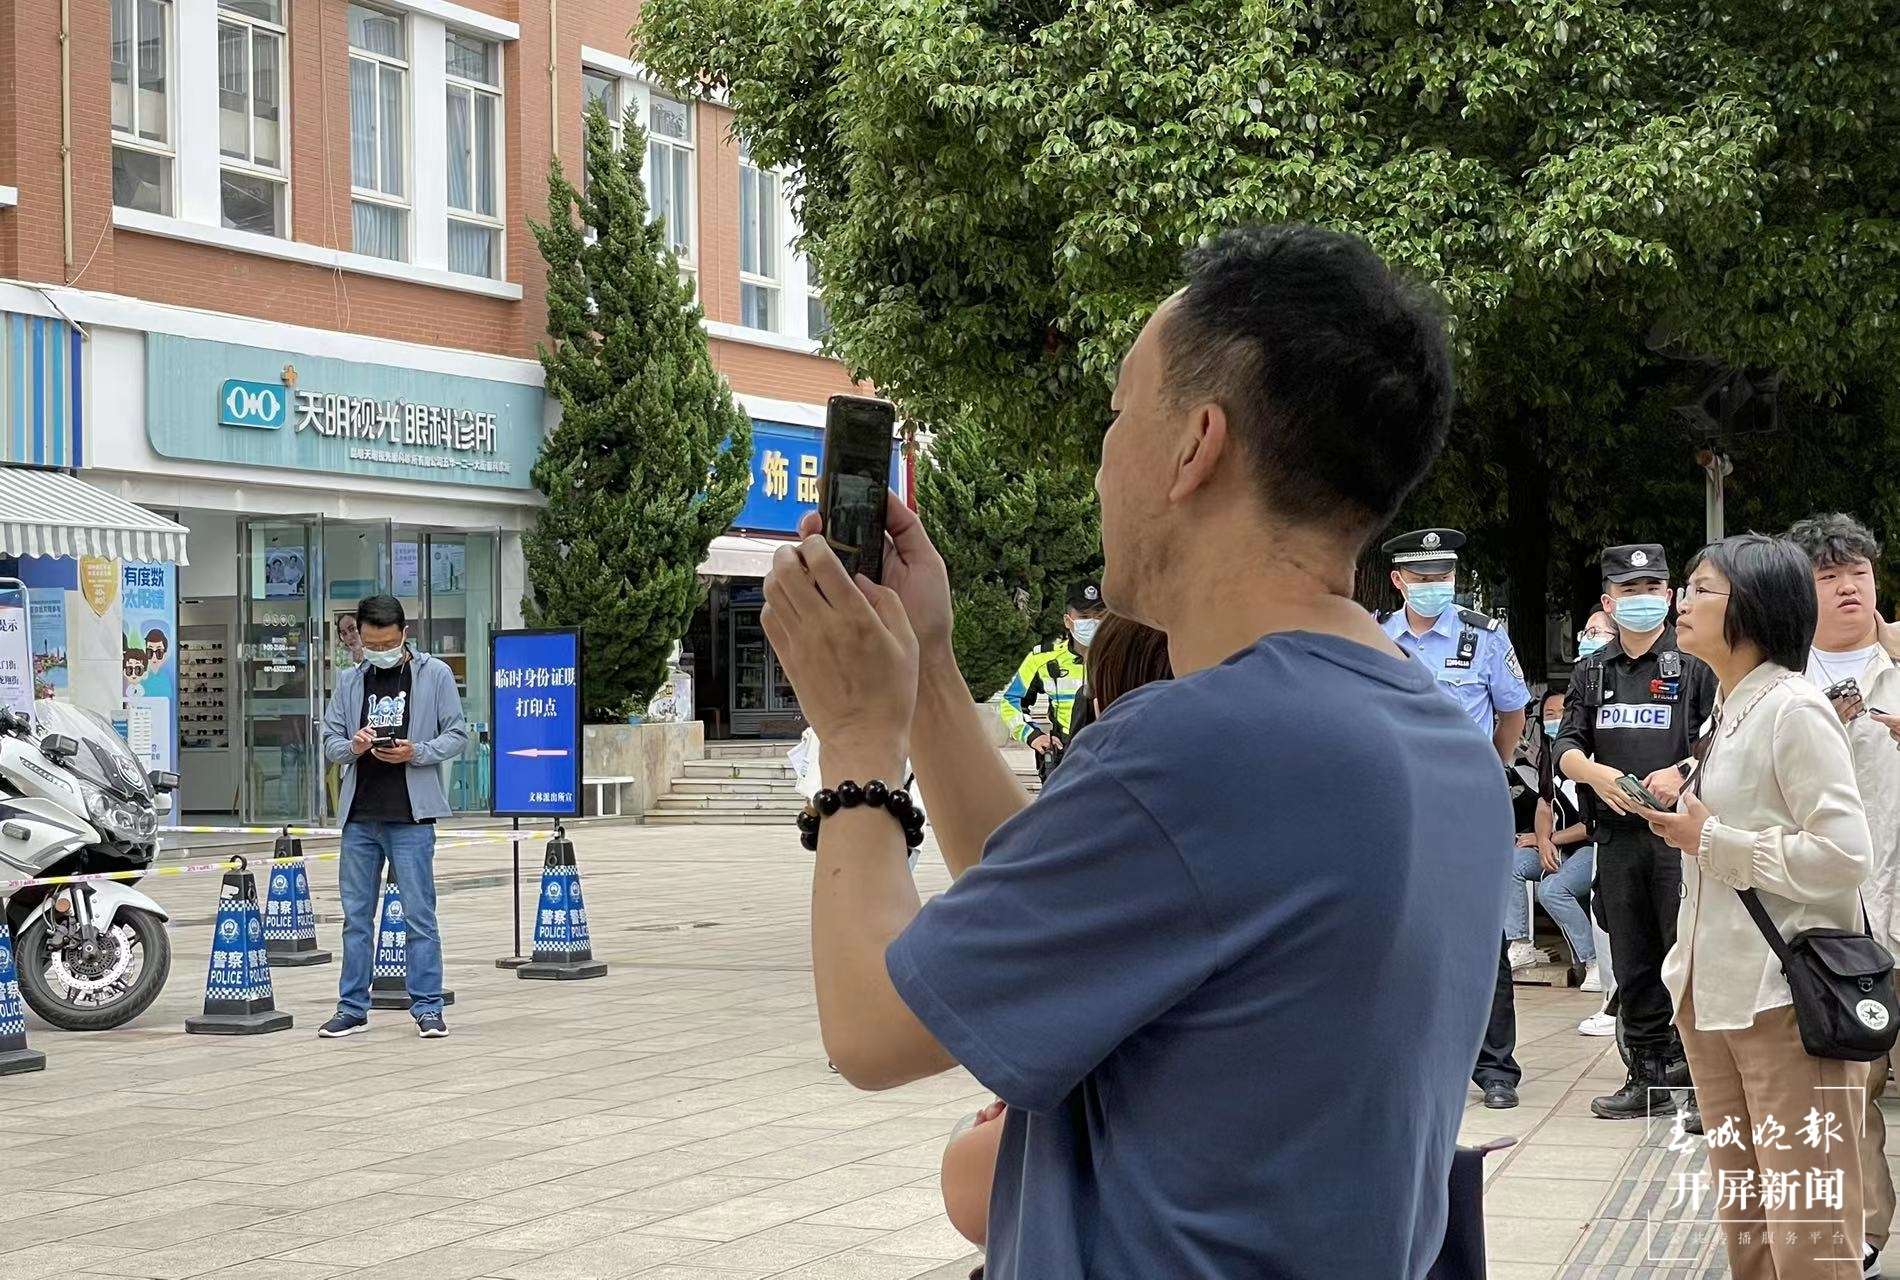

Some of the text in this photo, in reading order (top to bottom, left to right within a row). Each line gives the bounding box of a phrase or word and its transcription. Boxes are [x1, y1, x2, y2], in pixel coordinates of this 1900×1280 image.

[296, 390, 498, 452] 天明视光眼科诊所
[747, 450, 820, 502] 饰品
[124, 565, 165, 587] 有度数
[495, 667, 576, 688] 临时身份证明
[515, 697, 558, 718] 打印点
[1601, 708, 1666, 725] POLICE
[268, 900, 292, 915] 警察
[266, 916, 292, 928] POLICE
[541, 909, 566, 925] 警察
[540, 926, 566, 938] POLICE
[213, 950, 243, 969] 警察
[248, 948, 268, 968] 警察
[210, 969, 243, 985] POLICE
[0, 1001, 24, 1018] OLICE
